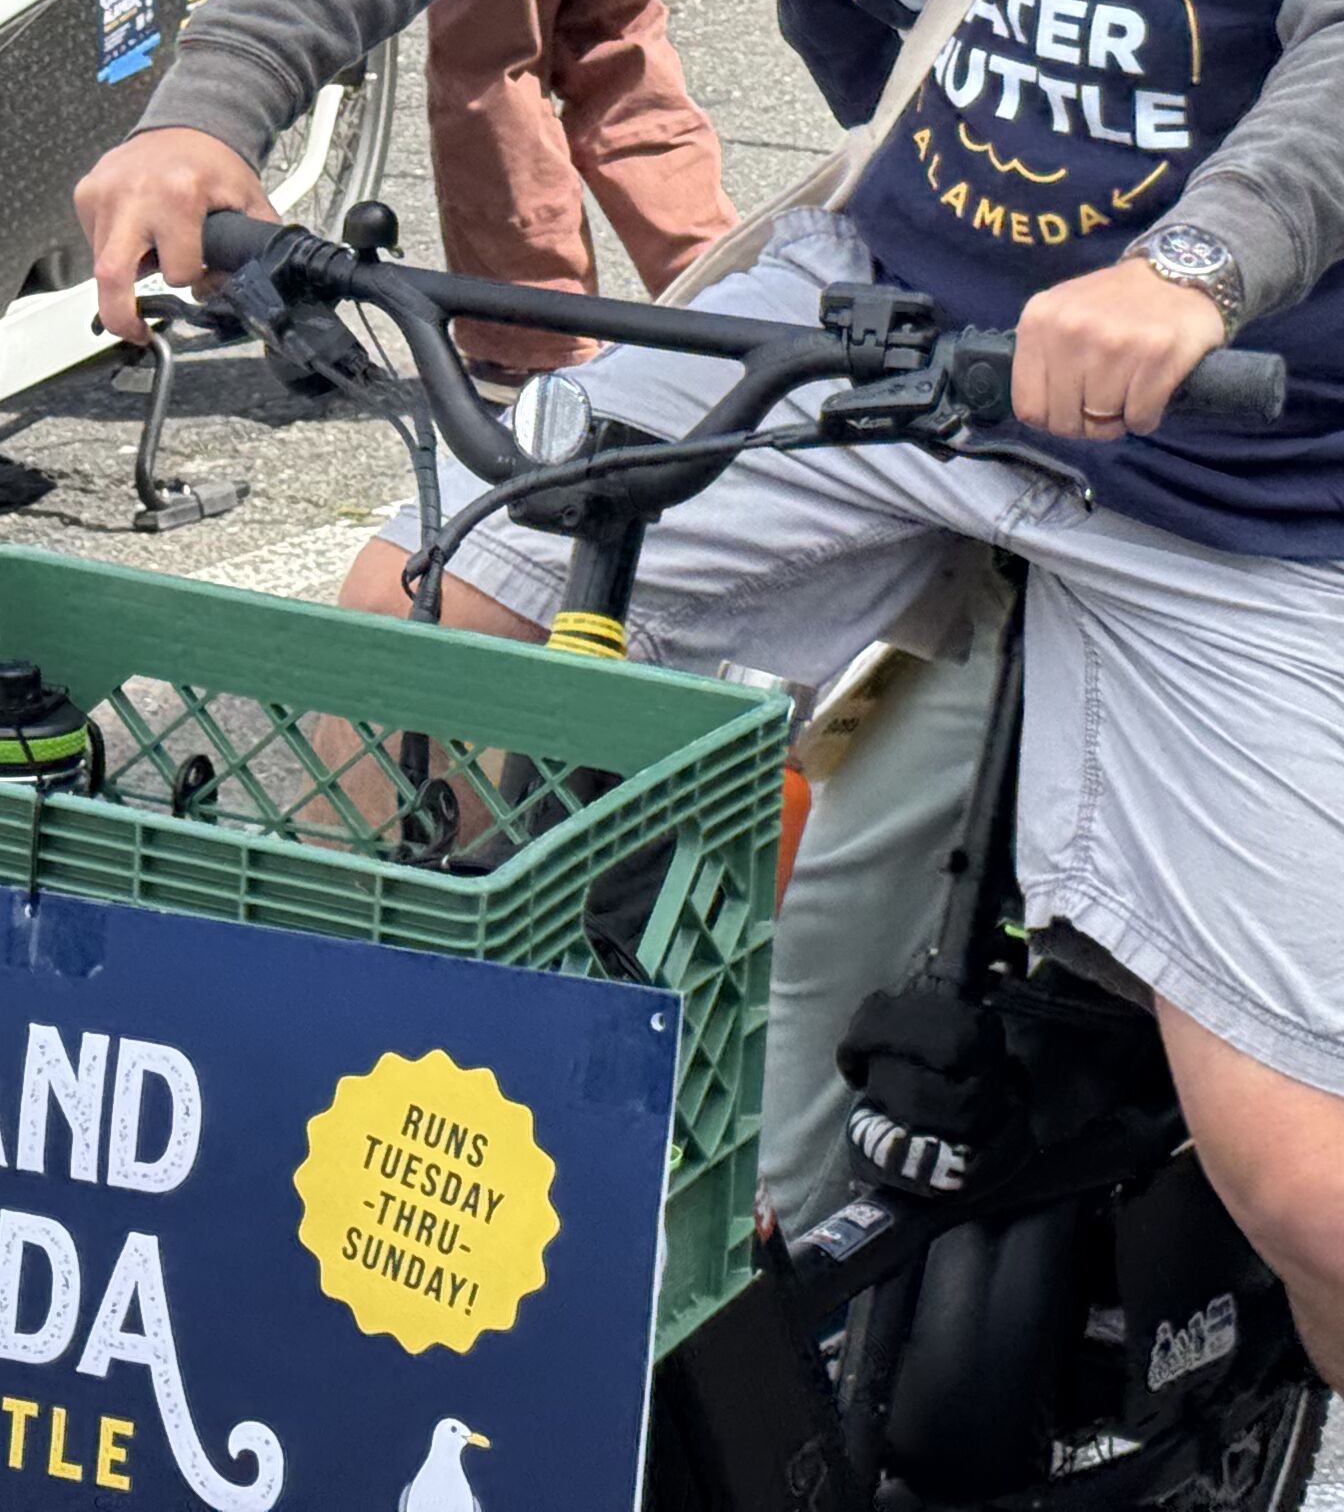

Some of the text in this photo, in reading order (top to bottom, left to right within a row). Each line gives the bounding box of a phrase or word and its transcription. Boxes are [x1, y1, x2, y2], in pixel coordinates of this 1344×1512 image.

[913, 126, 1110, 245] ALAMEDA
[363, 1134, 505, 1225] TUESDAY
[401, 1104, 489, 1168] RUNS
[363, 1190, 471, 1255] -THRU-
[342, 1226, 479, 1316] SUNDAY!
